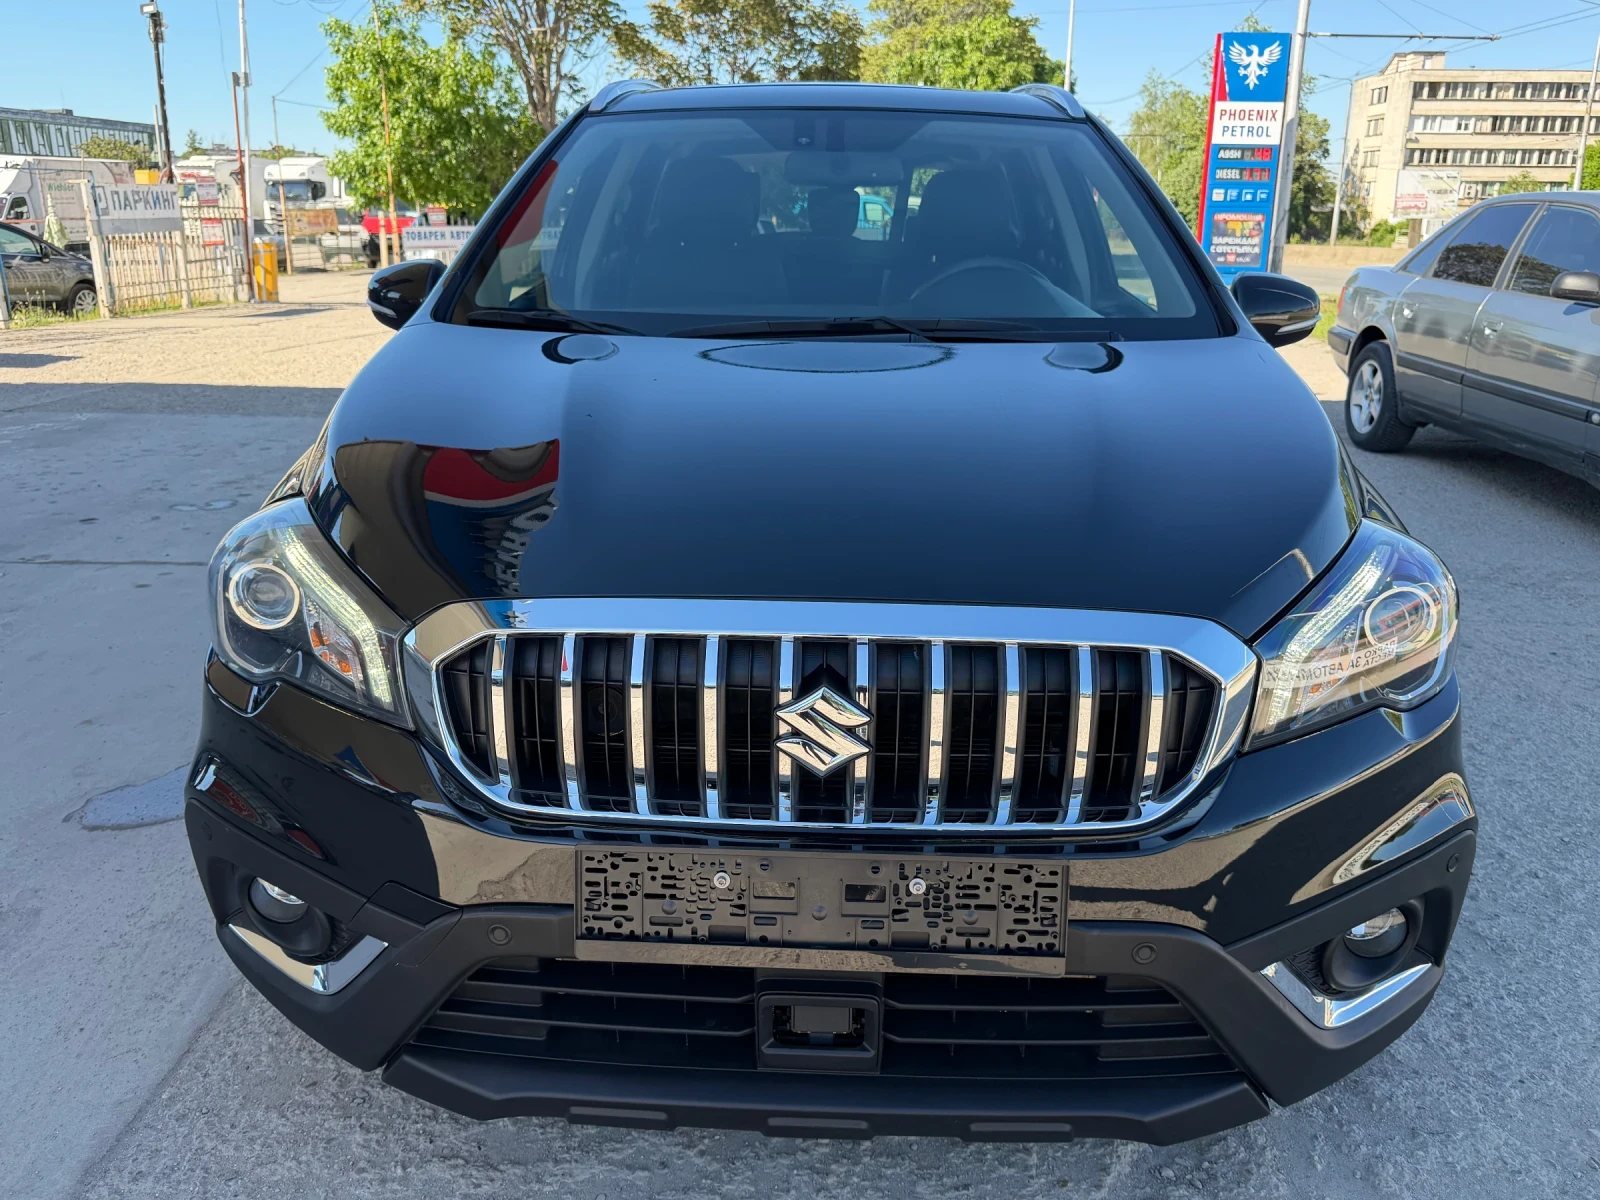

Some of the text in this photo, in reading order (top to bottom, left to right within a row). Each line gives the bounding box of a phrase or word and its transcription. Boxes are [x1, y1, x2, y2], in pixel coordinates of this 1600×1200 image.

[1219, 109, 1278, 121] PHOENIX
[1221, 125, 1272, 137] PETROL
[1215, 168, 1241, 179] DIESEL
[110, 187, 177, 211] ПАРКИНГ
[405, 230, 446, 241] ТОВАРЕН
